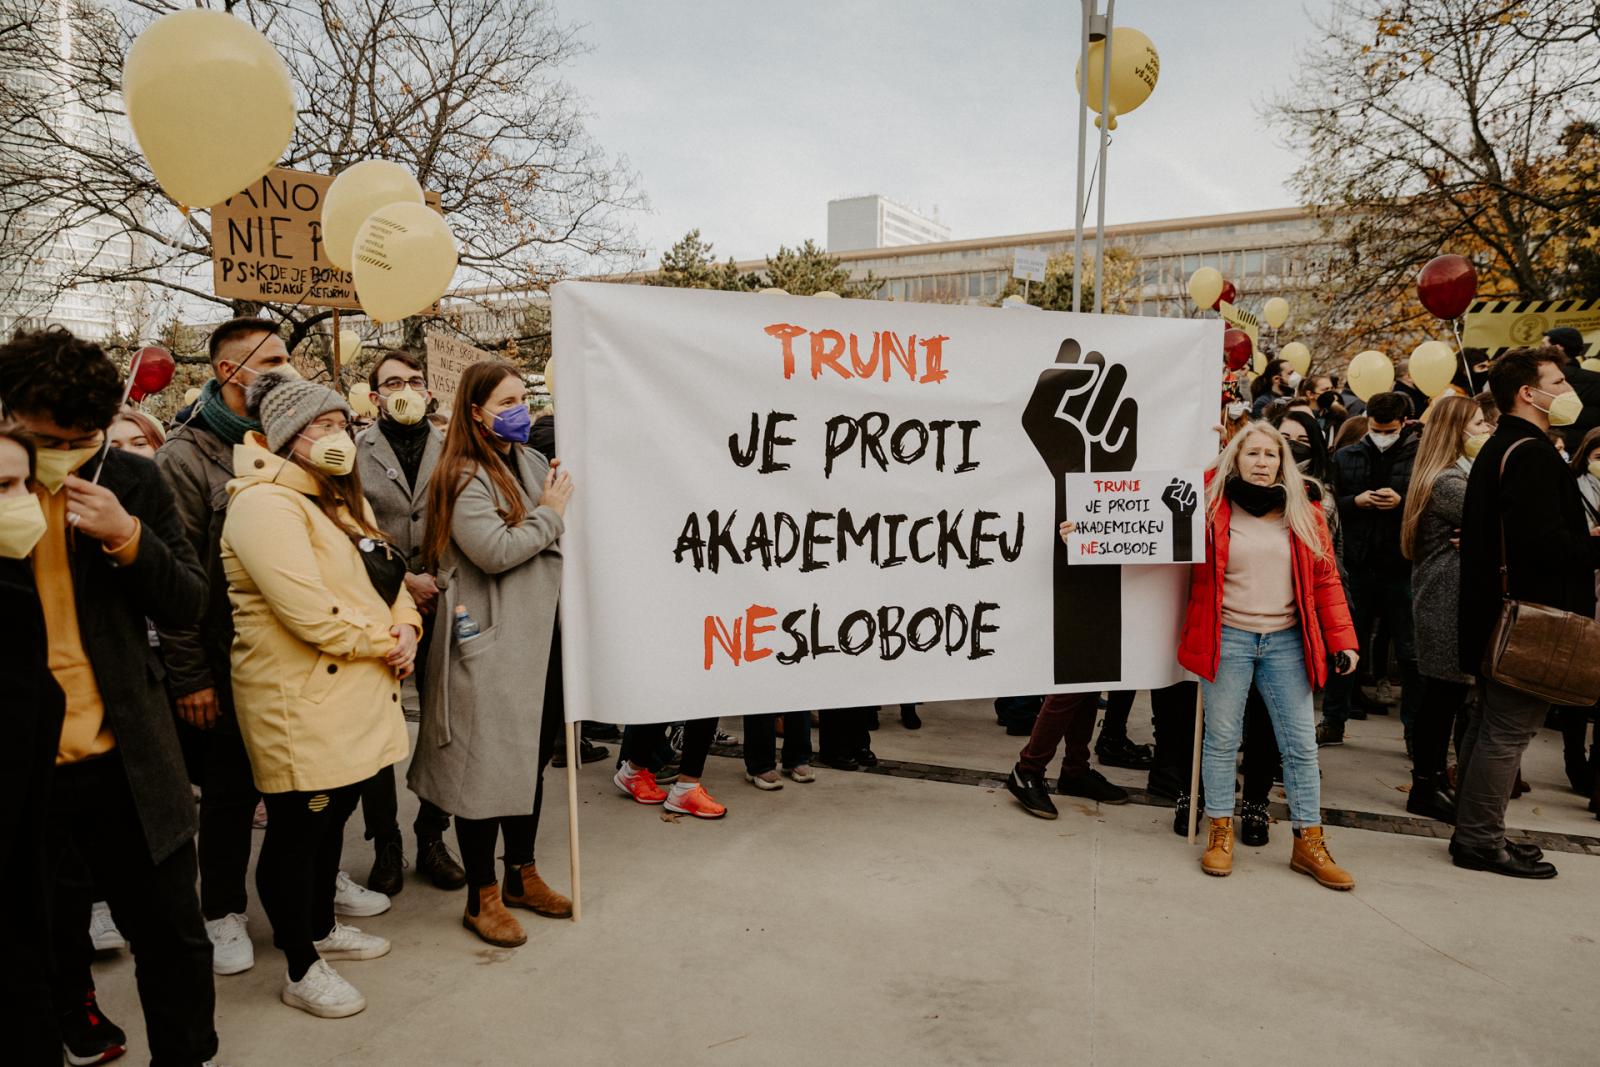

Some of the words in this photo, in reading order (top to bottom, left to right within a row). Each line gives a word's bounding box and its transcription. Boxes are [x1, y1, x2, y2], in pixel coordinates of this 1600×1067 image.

[228, 216, 293, 259] NIE
[291, 268, 308, 283] JE
[310, 266, 353, 284] BORIS
[763, 322, 950, 384] TRUNI
[440, 357, 454, 371] NIE
[727, 410, 797, 474] JE
[823, 411, 982, 479] PROTI
[1093, 479, 1141, 493] TRUNI
[1085, 499, 1102, 514] JE
[1108, 498, 1150, 514] PROTI
[1074, 520, 1164, 535] AKADEMICKEJ
[672, 507, 1025, 574] AKADEMICKEJ
[1080, 541, 1158, 556] NESLOBODE
[703, 600, 1001, 671] NESLOBODE
